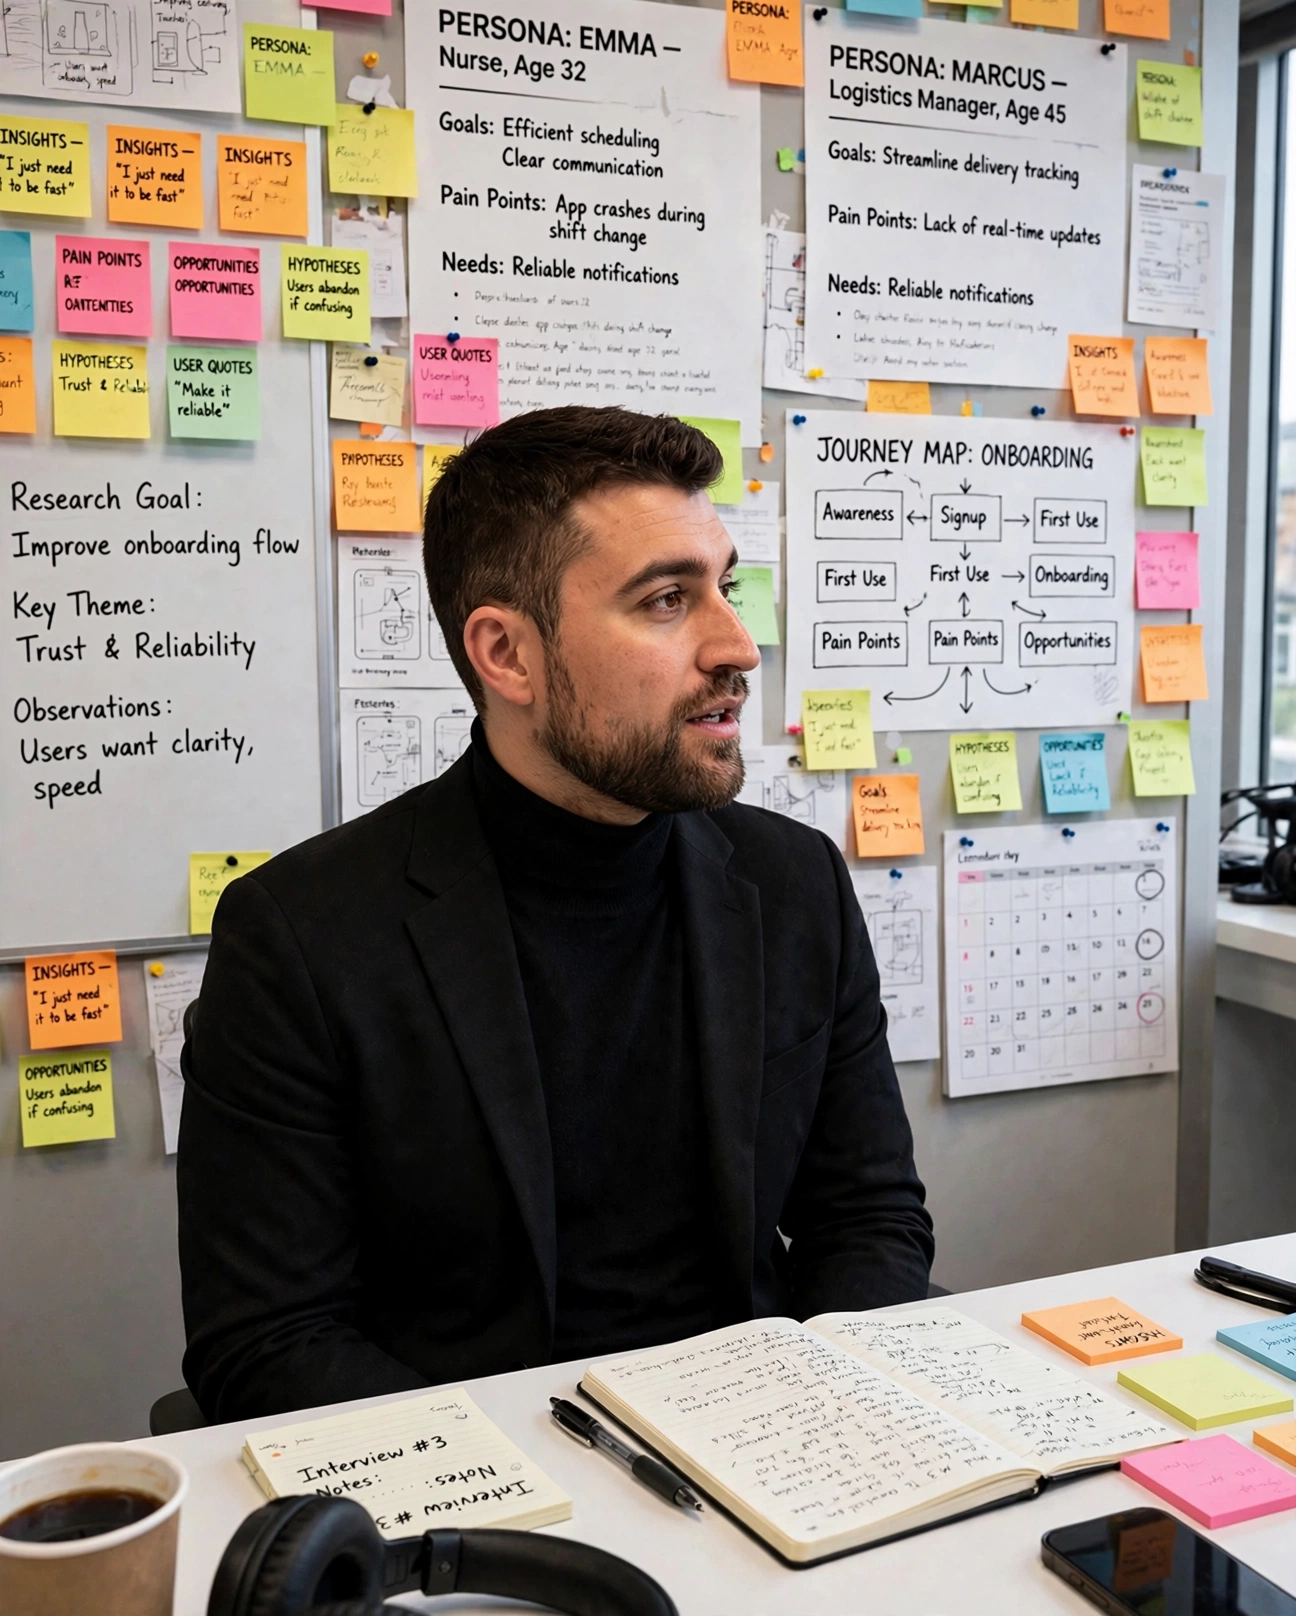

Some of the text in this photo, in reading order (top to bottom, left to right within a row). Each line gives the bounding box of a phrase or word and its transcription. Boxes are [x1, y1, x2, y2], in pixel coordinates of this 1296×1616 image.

[732, 0, 789, 19] PERSONA:
[438, 9, 572, 48] PERSONA:
[579, 27, 657, 57] EMMA
[251, 36, 311, 56] PERSONA:
[254, 59, 306, 77] EMMA
[439, 46, 587, 82] Nurse, Age 32
[830, 45, 1046, 91] PERSONA: MARCUS
[830, 80, 1066, 125] Logistics Manager, Age 45
[0, 128, 67, 149] INSIGHTS
[439, 111, 660, 157] Goals: Efficient scheduling
[115, 138, 178, 158] INSIGHTS
[225, 147, 293, 167] INSIGHTS
[18, 159, 41, 177] just
[47, 161, 73, 175] need
[502, 147, 664, 178] Clear communication
[828, 141, 1079, 189] Goals: Streamline delivery tracking
[9, 178, 21, 193] to
[26, 180, 39, 194] be
[133, 167, 155, 185] just
[160, 168, 185, 182] need
[110, 186, 119, 199] it
[125, 185, 135, 200] to
[139, 186, 152, 201] be
[440, 185, 706, 231] Pain Points: App crashes during
[549, 220, 647, 251] shift change
[828, 205, 1101, 247] Pain Points: Lack of real-time updates
[62, 248, 143, 268] PAIN POINTS
[173, 256, 259, 274] OPPORTUNITIES
[288, 257, 361, 275] HYPOTHESES
[442, 252, 679, 286] Needs: Reliable notifications
[175, 279, 255, 296] OPPORTUNITIES
[287, 279, 360, 296] Users abandon
[828, 274, 1034, 306] Needs: Reliable notifications
[290, 297, 353, 319] if confusing
[60, 353, 134, 370] HYPOTHESES
[419, 346, 448, 361] USER
[451, 348, 492, 363] QUOTES
[1074, 345, 1118, 360] INSIGHTS
[173, 358, 253, 375] USER QUOTES
[58, 376, 92, 391] Trust
[221, 383, 231, 397] it
[817, 436, 1094, 469] JOURNEY MAP: ONBOARDING
[11, 481, 203, 511] Research Goal:
[823, 502, 894, 522] Awareness
[941, 506, 986, 531] Signup
[1041, 509, 1098, 528] First Use
[11, 528, 300, 568] Improve onboarding flow
[825, 569, 887, 588] First Use
[931, 564, 989, 583] First Use
[1035, 565, 1109, 591] Onboarding
[13, 589, 155, 630] Key Theme:
[822, 631, 900, 651] Pain Points
[934, 630, 999, 647] Pain Points
[1024, 631, 1111, 654] Opportunities
[16, 632, 256, 670] Trust & Reliability
[13, 695, 172, 723] Observations:
[20, 728, 254, 764] Users want clarity,
[955, 740, 1010, 753] HYPOTHESES
[1043, 738, 1104, 752] OPPORTUNITIES
[34, 769, 102, 809] speed
[32, 962, 96, 981] INSIGHTS
[52, 989, 72, 1009] just
[77, 985, 100, 1000] need
[36, 1013, 44, 1025] it
[50, 1012, 60, 1024] to
[65, 1009, 77, 1022] be
[25, 1058, 107, 1081] OPPORTUNITIES
[25, 1080, 102, 1101] Users abandon
[28, 1101, 94, 1119] if confusing
[297, 1435, 448, 1483] Interview #3
[316, 1474, 382, 1497] Notes:
[425, 1465, 497, 1489] Notes:
[424, 1480, 535, 1516] Interview
